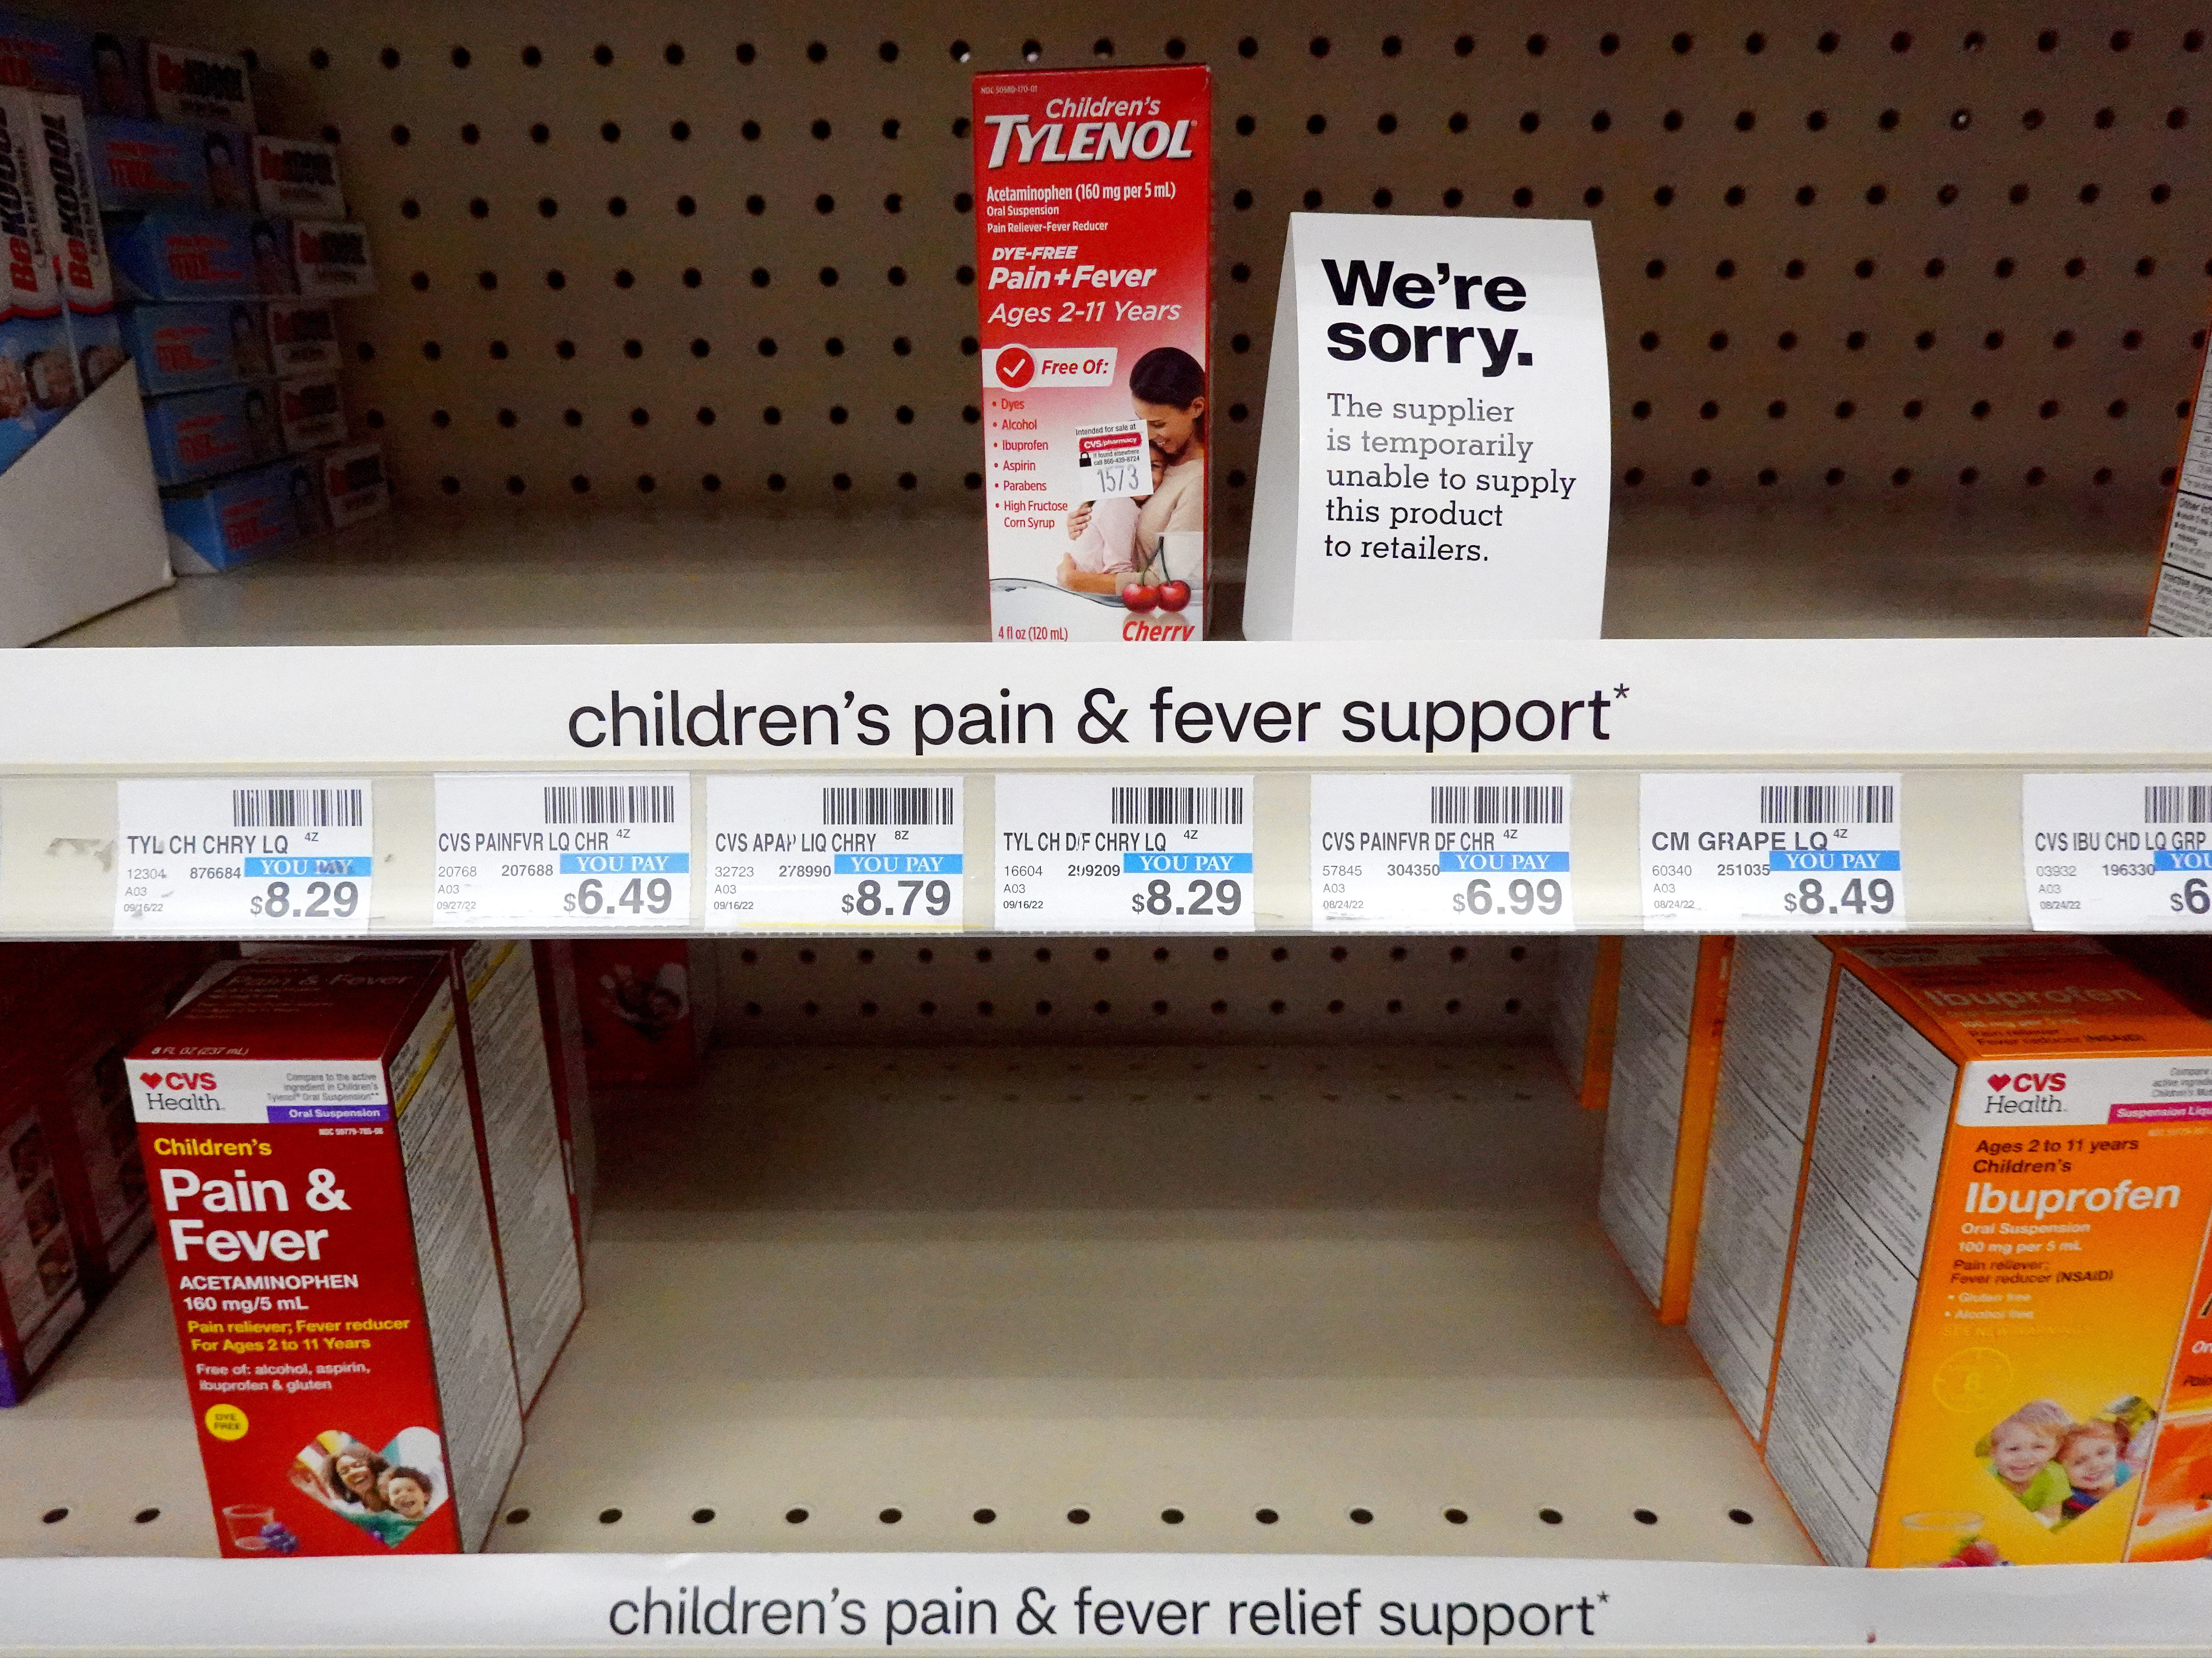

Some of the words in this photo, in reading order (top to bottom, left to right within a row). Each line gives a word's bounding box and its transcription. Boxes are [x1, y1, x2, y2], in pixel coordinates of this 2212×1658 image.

[1046, 96, 1161, 119] Children’s
[984, 114, 1193, 169] TYLENOL
[986, 184, 1072, 203] Acetaminophen
[1076, 183, 1099, 202] (160
[1103, 186, 1120, 201] mg
[1124, 186, 1142, 201] per
[1145, 182, 1152, 198] 5
[1154, 182, 1176, 200] mL)
[987, 206, 1005, 216] Oral
[1007, 205, 1059, 217] Suspension
[987, 222, 1005, 233] Pain
[1008, 221, 1071, 233] Reliever-Fever
[1072, 221, 1108, 231] Reducer
[992, 246, 1078, 261] DYE-FREE
[1321, 259, 1526, 312] We’re
[988, 303, 1052, 327] Ages
[1058, 301, 1106, 322] 2-11
[1115, 301, 1182, 321] Years
[1327, 321, 1533, 377] sorry.
[1041, 360, 1078, 375] Free
[1083, 359, 1109, 374] Of:
[1001, 398, 1024, 411] Dyes
[1327, 393, 1382, 419] The
[1393, 398, 1515, 426] supplier
[1002, 419, 1038, 430] Alcohol
[1076, 427, 1103, 435] Intended
[1002, 439, 1048, 451] Ibuprofen
[1084, 437, 1137, 449] CVS/pharmacy
[1327, 428, 1350, 451] is
[1362, 429, 1533, 463] temporarily
[1003, 460, 1036, 472] Aspirin
[1004, 480, 1046, 491] Parabens
[1327, 463, 1428, 489] unable
[1440, 468, 1466, 491] to
[1476, 469, 1576, 499] supply
[1004, 500, 1026, 512] High
[1028, 500, 1068, 511] Fructose
[1326, 497, 1379, 522] this
[1390, 501, 1503, 529] product
[1004, 517, 1025, 528] Corn
[1027, 517, 1055, 529] Syrup
[1325, 535, 1351, 557] to
[1361, 536, 1488, 562] retailers.
[999, 626, 1004, 639] 4
[1007, 626, 1012, 639] fl
[1016, 628, 1026, 639] oz
[1029, 626, 1048, 642] (120
[1050, 627, 1068, 642] mL)
[1122, 620, 1195, 642] Cherry
[569, 689, 890, 747] children’s
[914, 688, 1053, 756] pain
[1077, 688, 1129, 744] &
[1150, 686, 1320, 743] fever
[127, 836, 164, 854] TYL
[169, 836, 196, 854] CH
[203, 836, 256, 854] CHRY
[263, 835, 288, 855] LQ
[439, 833, 470, 852] CVS
[476, 833, 543, 852] PAINFVR
[549, 832, 570, 852] LQ
[575, 832, 608, 851] CHR
[617, 829, 630, 838] 4Z
[716, 833, 747, 852] CVS
[802, 833, 826, 852] LIQ
[831, 833, 876, 852] CHRY
[894, 830, 909, 840] 8Z
[1004, 832, 1033, 851] TYL
[1038, 832, 1060, 851] CH
[1095, 832, 1140, 851] CHRY
[1146, 832, 1166, 852] LQ
[1184, 830, 1198, 839] 4Z
[1322, 832, 1355, 851] CVS
[1361, 832, 1429, 851] PAINFVR
[1435, 832, 1455, 851] DF
[1460, 832, 1494, 851] CHR
[1652, 832, 1689, 851] CM
[1698, 831, 1786, 851] GRAPE
[1795, 832, 1828, 851] LQ
[1833, 829, 1848, 838] 4Z
[2035, 832, 2068, 851] CVS
[2073, 832, 2100, 851] IBU
[2105, 832, 2140, 851] CHD
[2145, 832, 2167, 850] LQ
[2172, 832, 2206, 850] GRP
[190, 867, 241, 879] 876684
[438, 866, 477, 877] 20768
[502, 864, 553, 876] 207688
[576, 856, 624, 872] YOU
[632, 856, 669, 871] PAY
[715, 866, 754, 877] 32723
[779, 865, 831, 877] 278990
[1139, 856, 1188, 872] YOU
[1196, 856, 1233, 871] PAY
[1387, 864, 1440, 876] 304350
[1717, 864, 1770, 876] 251035
[563, 878, 672, 915] $6.49
[841, 879, 951, 916] $8.79
[1004, 884, 1026, 894] A03
[1132, 879, 1242, 916] $8.29
[1453, 879, 1562, 916] $6.99
[1784, 878, 1894, 915] $8.49
[250, 881, 359, 918] $8.29
[1003, 901, 1043, 910] 09/16/22
[165, 1072, 217, 1090] CVS
[2013, 1072, 2066, 1092] CVS
[154, 1138, 272, 1156] Children’s
[1976, 1140, 2023, 1156] Ages
[2028, 1139, 2040, 1152] 2
[2044, 1140, 2061, 1152] to
[2067, 1139, 2083, 1151] 11
[2090, 1139, 2139, 1154] years
[1973, 1158, 2072, 1173] Children’s
[160, 1168, 289, 1212] Pain
[306, 1168, 352, 1211] &
[1964, 1179, 2181, 1220] Ibuprofen
[169, 1219, 328, 1262] Fever
[180, 1275, 359, 1290] ACETAMINOPHEN
[184, 1297, 216, 1311] 160
[221, 1297, 271, 1314] mg/5
[277, 1296, 309, 1311] mL
[188, 1320, 224, 1333] Pain
[296, 1319, 342, 1333] Fever
[345, 1318, 410, 1331] reducer
[191, 1339, 221, 1351] For
[223, 1339, 264, 1353] Ages
[268, 1338, 278, 1350] 2
[282, 1339, 298, 1350] to
[303, 1338, 318, 1350] 11
[324, 1337, 371, 1350] Years
[196, 1364, 229, 1375] Free
[610, 1586, 866, 1636] children’s
[886, 1587, 996, 1645] pain
[1016, 1586, 1057, 1635] &
[1074, 1585, 1210, 1636] fever
[1230, 1588, 1361, 1636] relief
